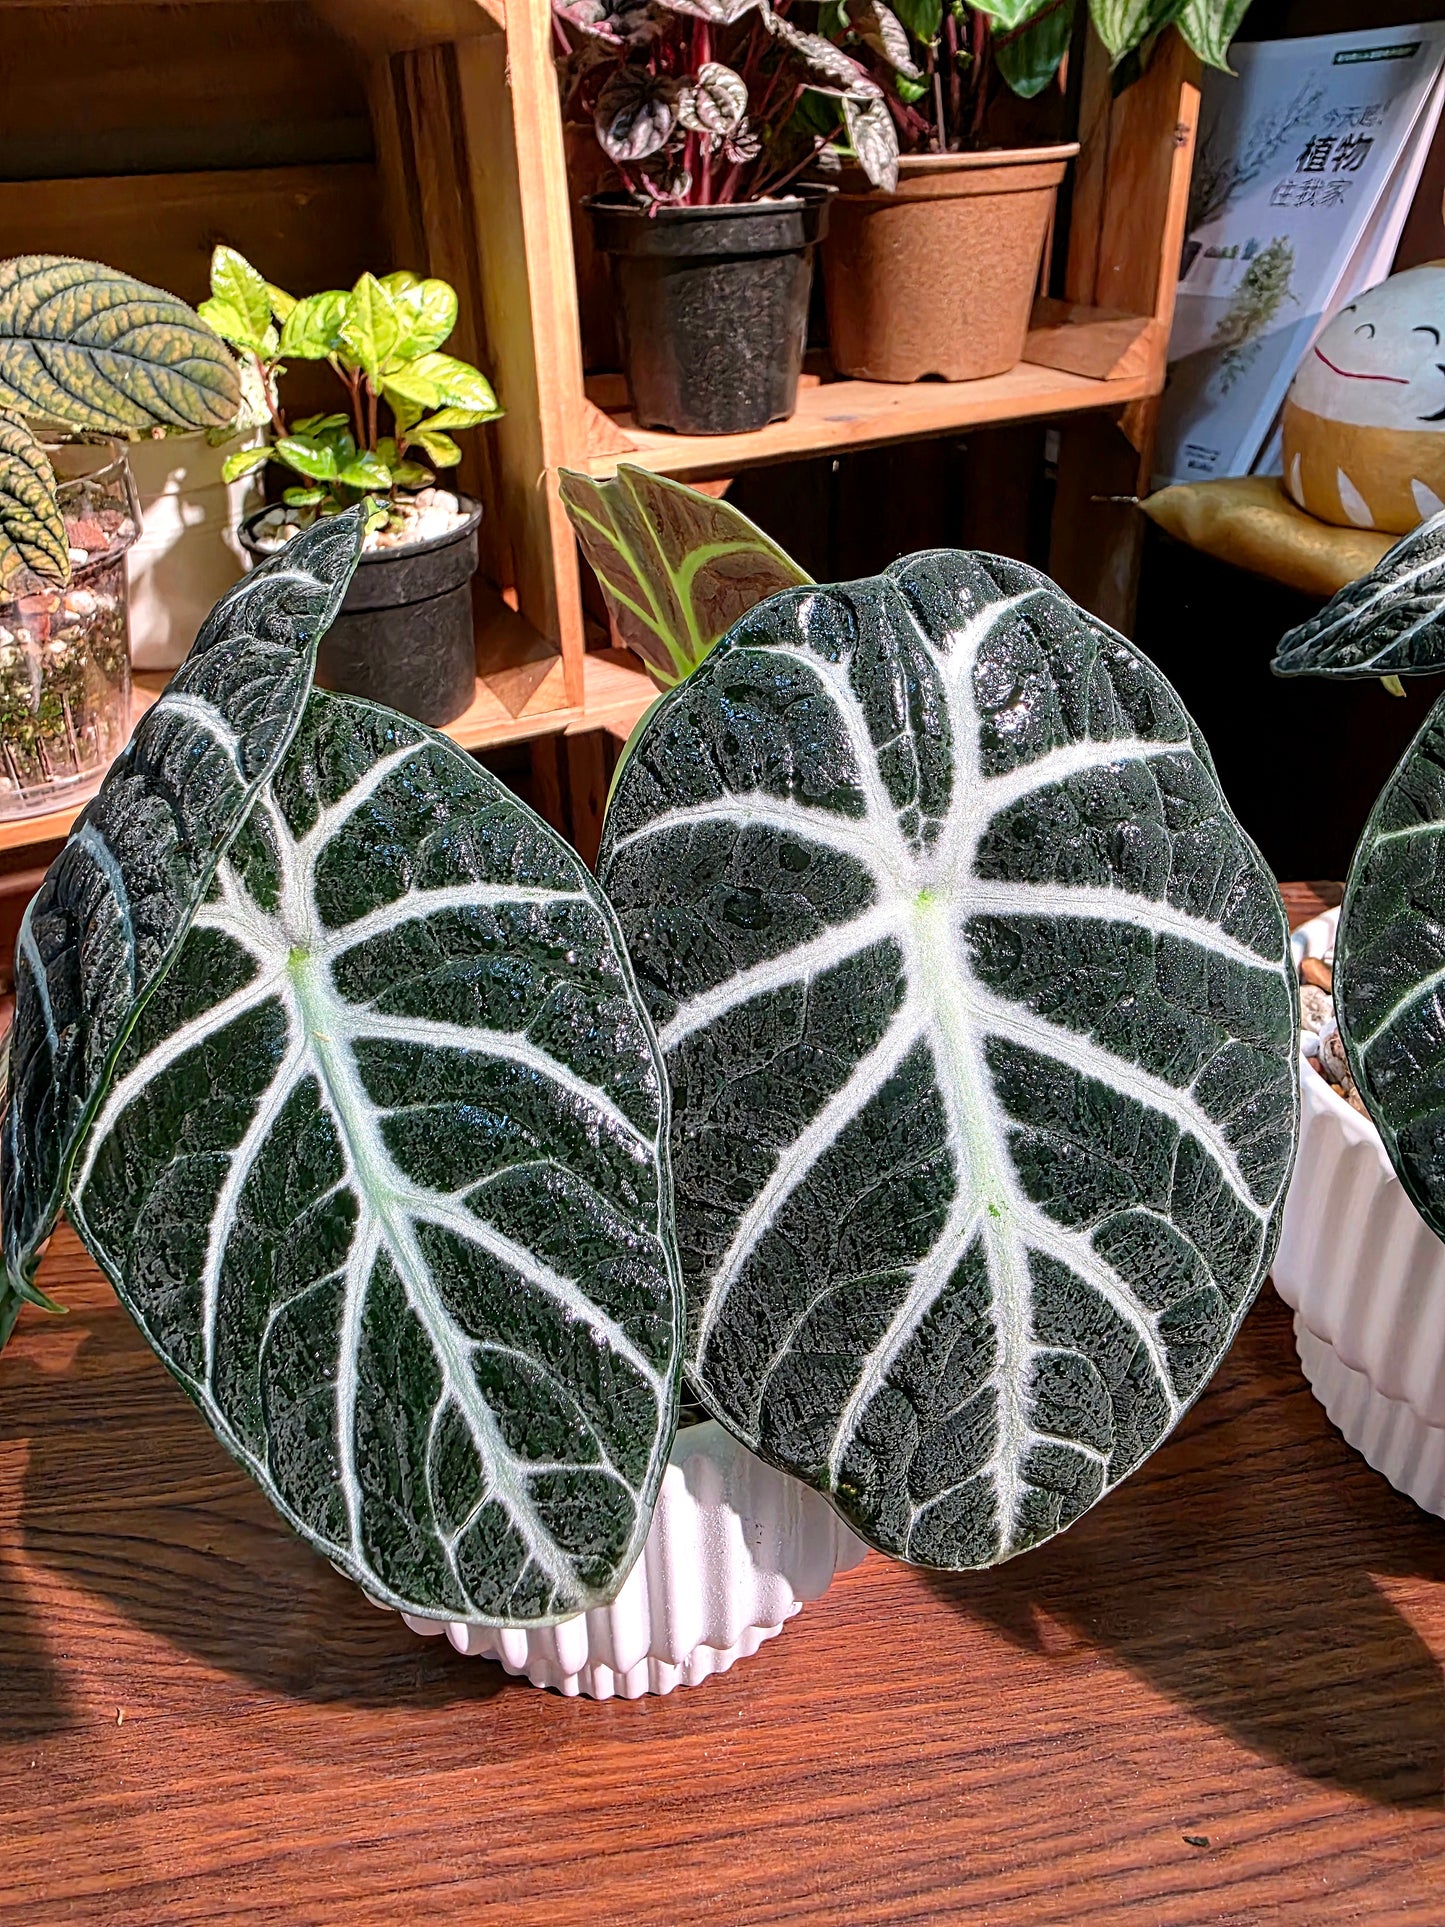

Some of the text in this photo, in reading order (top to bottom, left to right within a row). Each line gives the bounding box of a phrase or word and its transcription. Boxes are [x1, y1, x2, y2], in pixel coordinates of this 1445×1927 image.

[1296, 132, 1375, 173] 植物
[1269, 178, 1353, 207] 住我家
